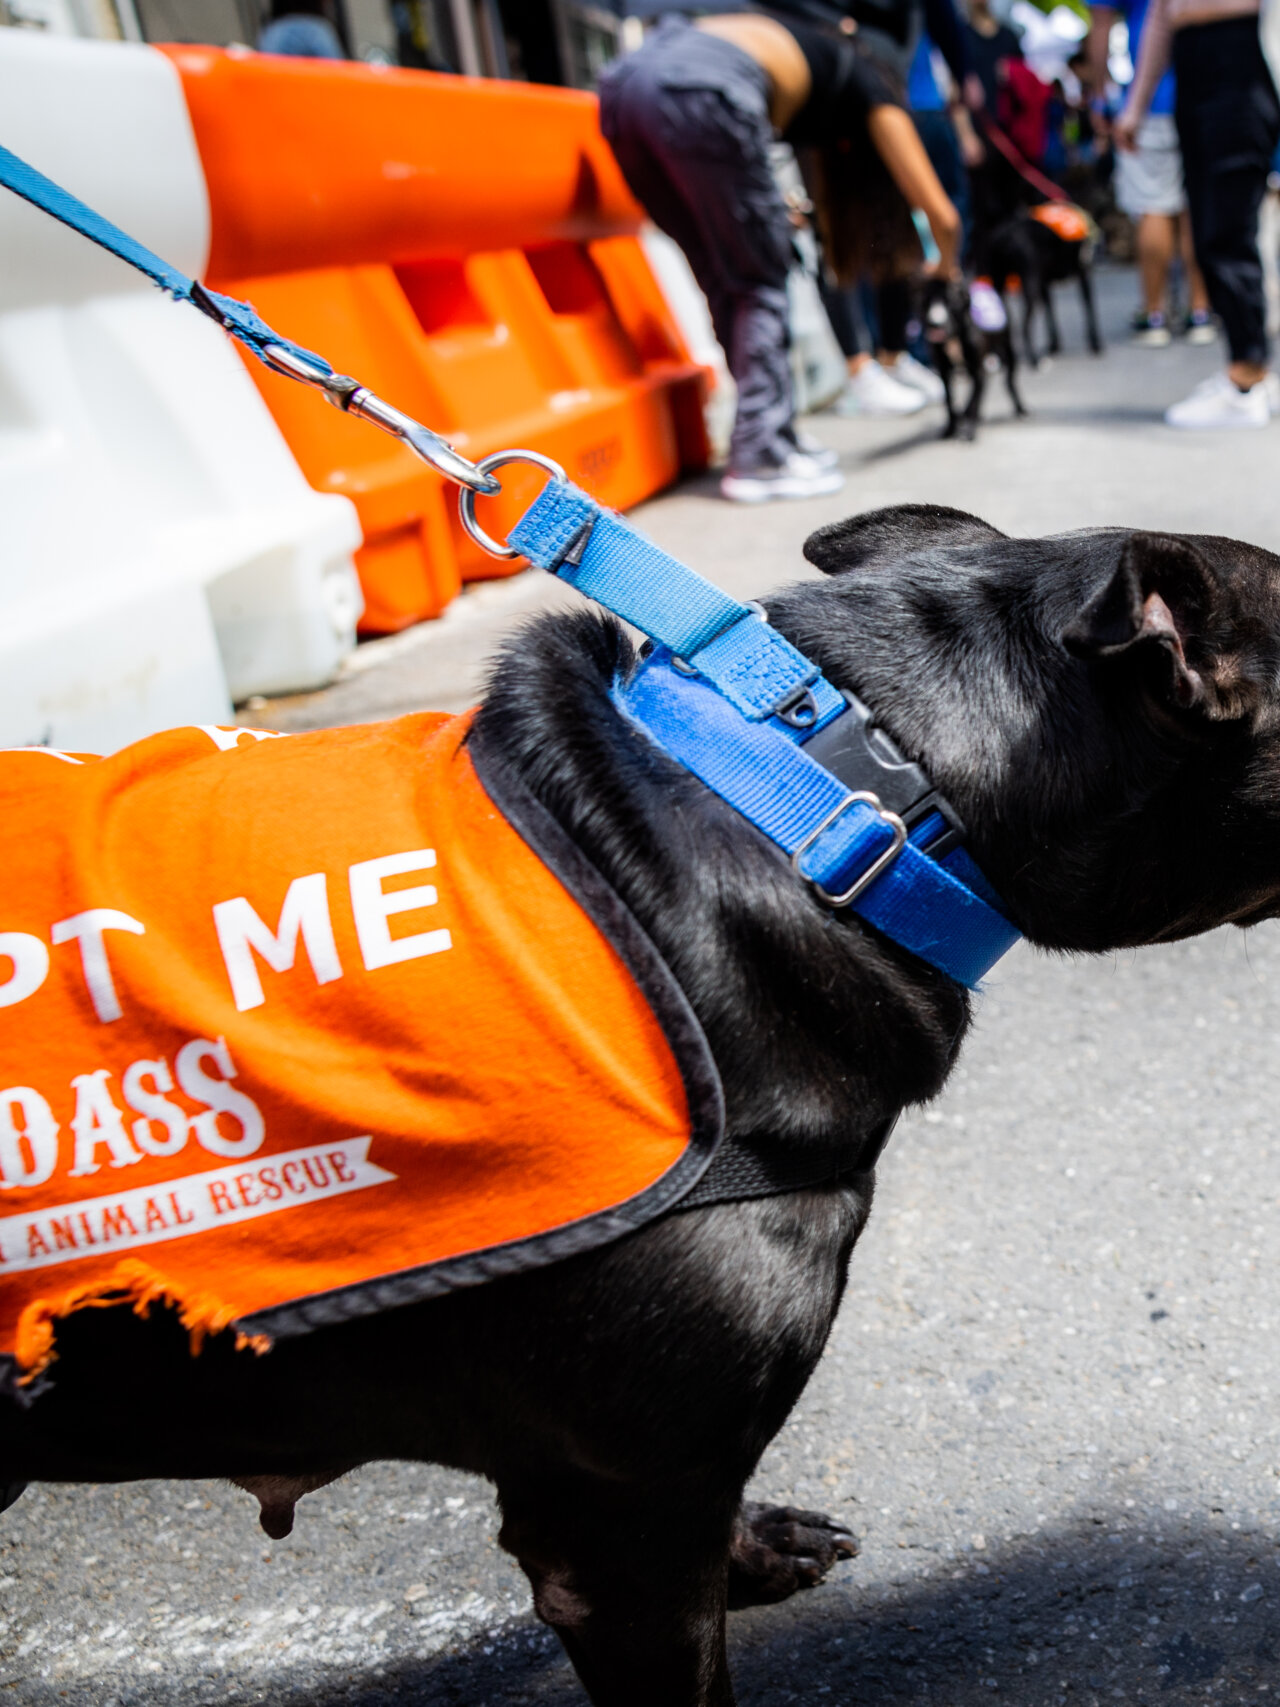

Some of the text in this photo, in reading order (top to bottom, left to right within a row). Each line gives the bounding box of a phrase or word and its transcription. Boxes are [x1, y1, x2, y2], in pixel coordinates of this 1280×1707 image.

[213, 848, 452, 1012] ME
[27, 1151, 356, 1258] ANIMAL RESCUE
